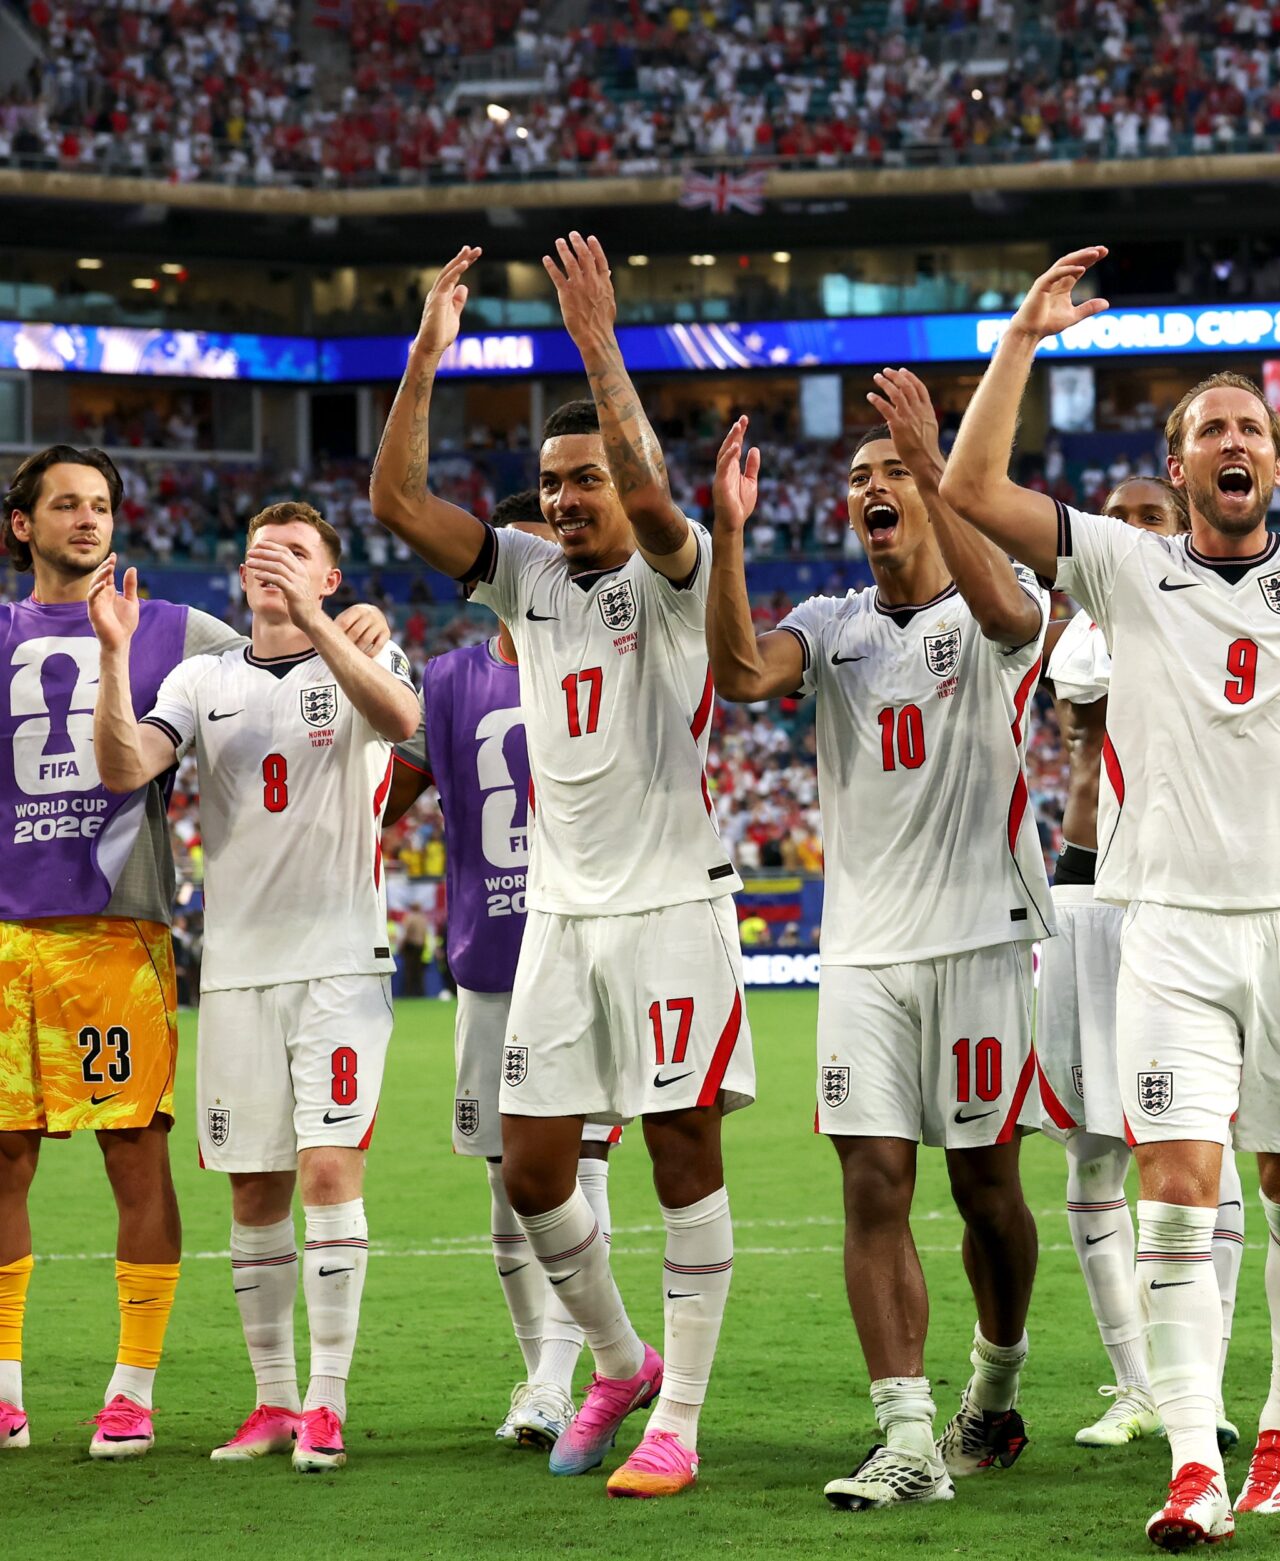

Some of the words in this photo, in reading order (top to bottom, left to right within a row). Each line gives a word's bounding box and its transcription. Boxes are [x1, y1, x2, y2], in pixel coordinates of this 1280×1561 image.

[1061, 313, 1194, 350] WORLD
[1195, 310, 1273, 345] CUP
[613, 632, 639, 647] NORWAY
[1224, 638, 1258, 705] 9
[561, 667, 603, 737] 17
[308, 729, 335, 739] NORWAY
[878, 704, 926, 771] 10
[39, 760, 80, 780] FIFA
[263, 753, 288, 813] 8
[15, 799, 68, 818] WORLD
[71, 798, 108, 813] CUP
[14, 815, 105, 844] 2026
[509, 834, 528, 853] FI
[484, 874, 527, 892] WOR
[486, 891, 528, 917] 20
[647, 997, 695, 1066] 17
[78, 1025, 132, 1084] 23
[952, 1037, 1002, 1103] 10
[331, 1046, 358, 1106] 8
